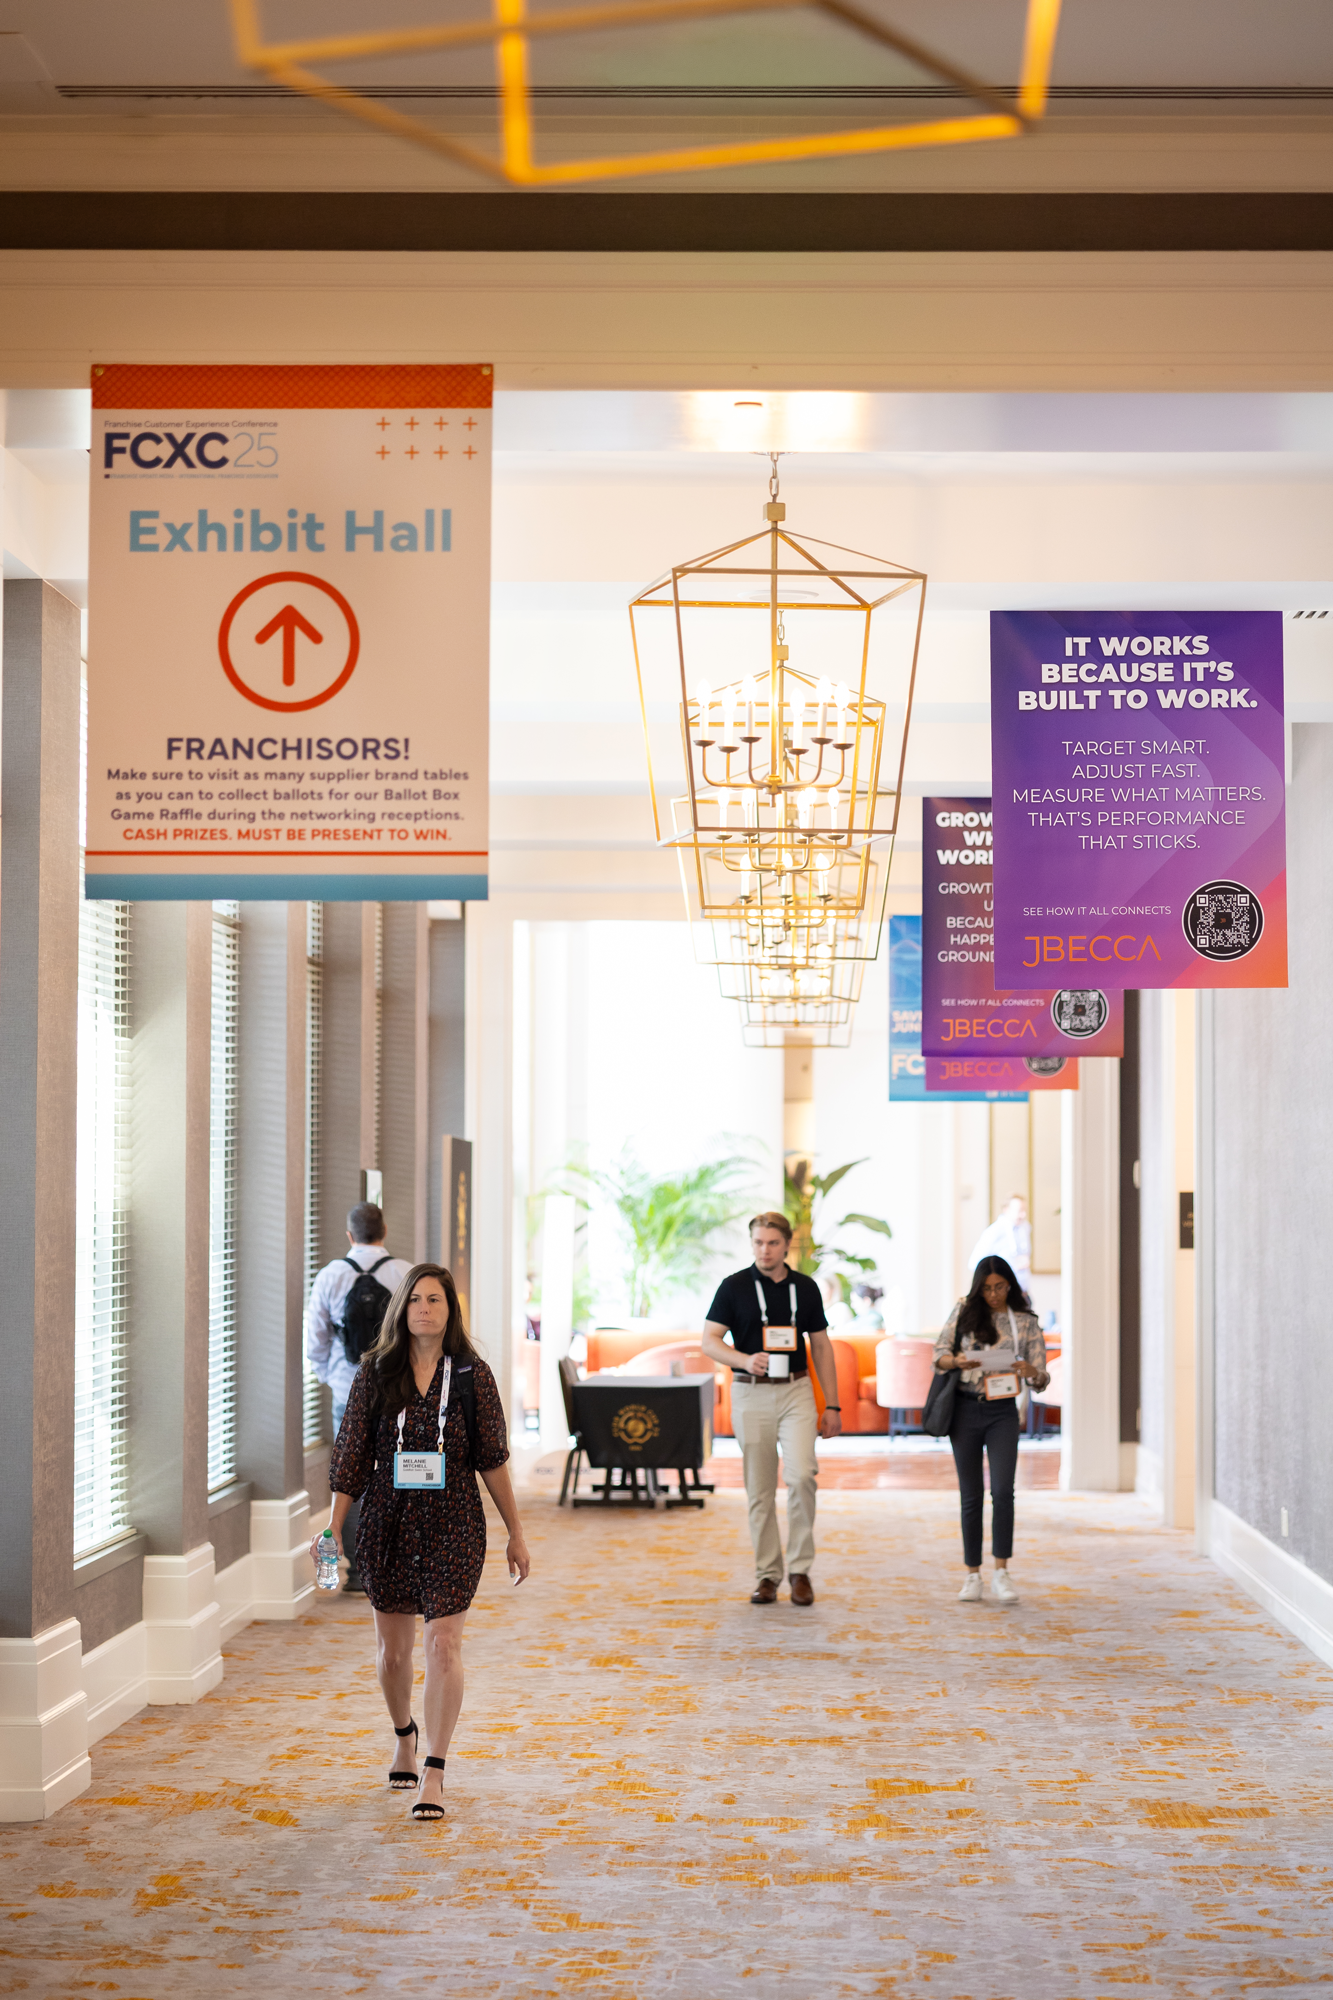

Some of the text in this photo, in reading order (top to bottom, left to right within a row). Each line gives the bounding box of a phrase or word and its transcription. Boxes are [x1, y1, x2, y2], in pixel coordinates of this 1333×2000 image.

[103, 420, 279, 430] Franchise Customer Experience Conference
[129, 508, 452, 553] Exhibit Hall
[1065, 635, 1210, 657] IT WORKS
[1041, 660, 1235, 684] BECAUSE IT’S
[1018, 688, 1258, 711] BUILT TO WORK.
[166, 737, 410, 761] FRANCHISORS!
[1061, 739, 1210, 756] TARGET SMART.
[106, 768, 469, 784] Make sure to visit as many supplier brand tables
[1071, 763, 1200, 779] ADJUST FAST.
[115, 788, 460, 804] as you can to collect ballots for our Ballot Box
[1013, 786, 1266, 804] MEASURE WHAT MATTERS.
[110, 807, 465, 824] Game Raffle during the networking receptions.
[1027, 810, 1246, 827] THAT’S PERFORMANCE
[122, 828, 452, 841] CASH PRIZES. MUST BE PRESENT TO WIN.
[1077, 834, 1201, 850] THAT STICKS.
[936, 848, 994, 866] WOR
[938, 882, 994, 895] GROWT
[1022, 905, 1172, 917] SEE HOW IT ALL CONNECTS
[941, 998, 1045, 1007] SEE HOW IT ALL CONNECTS
